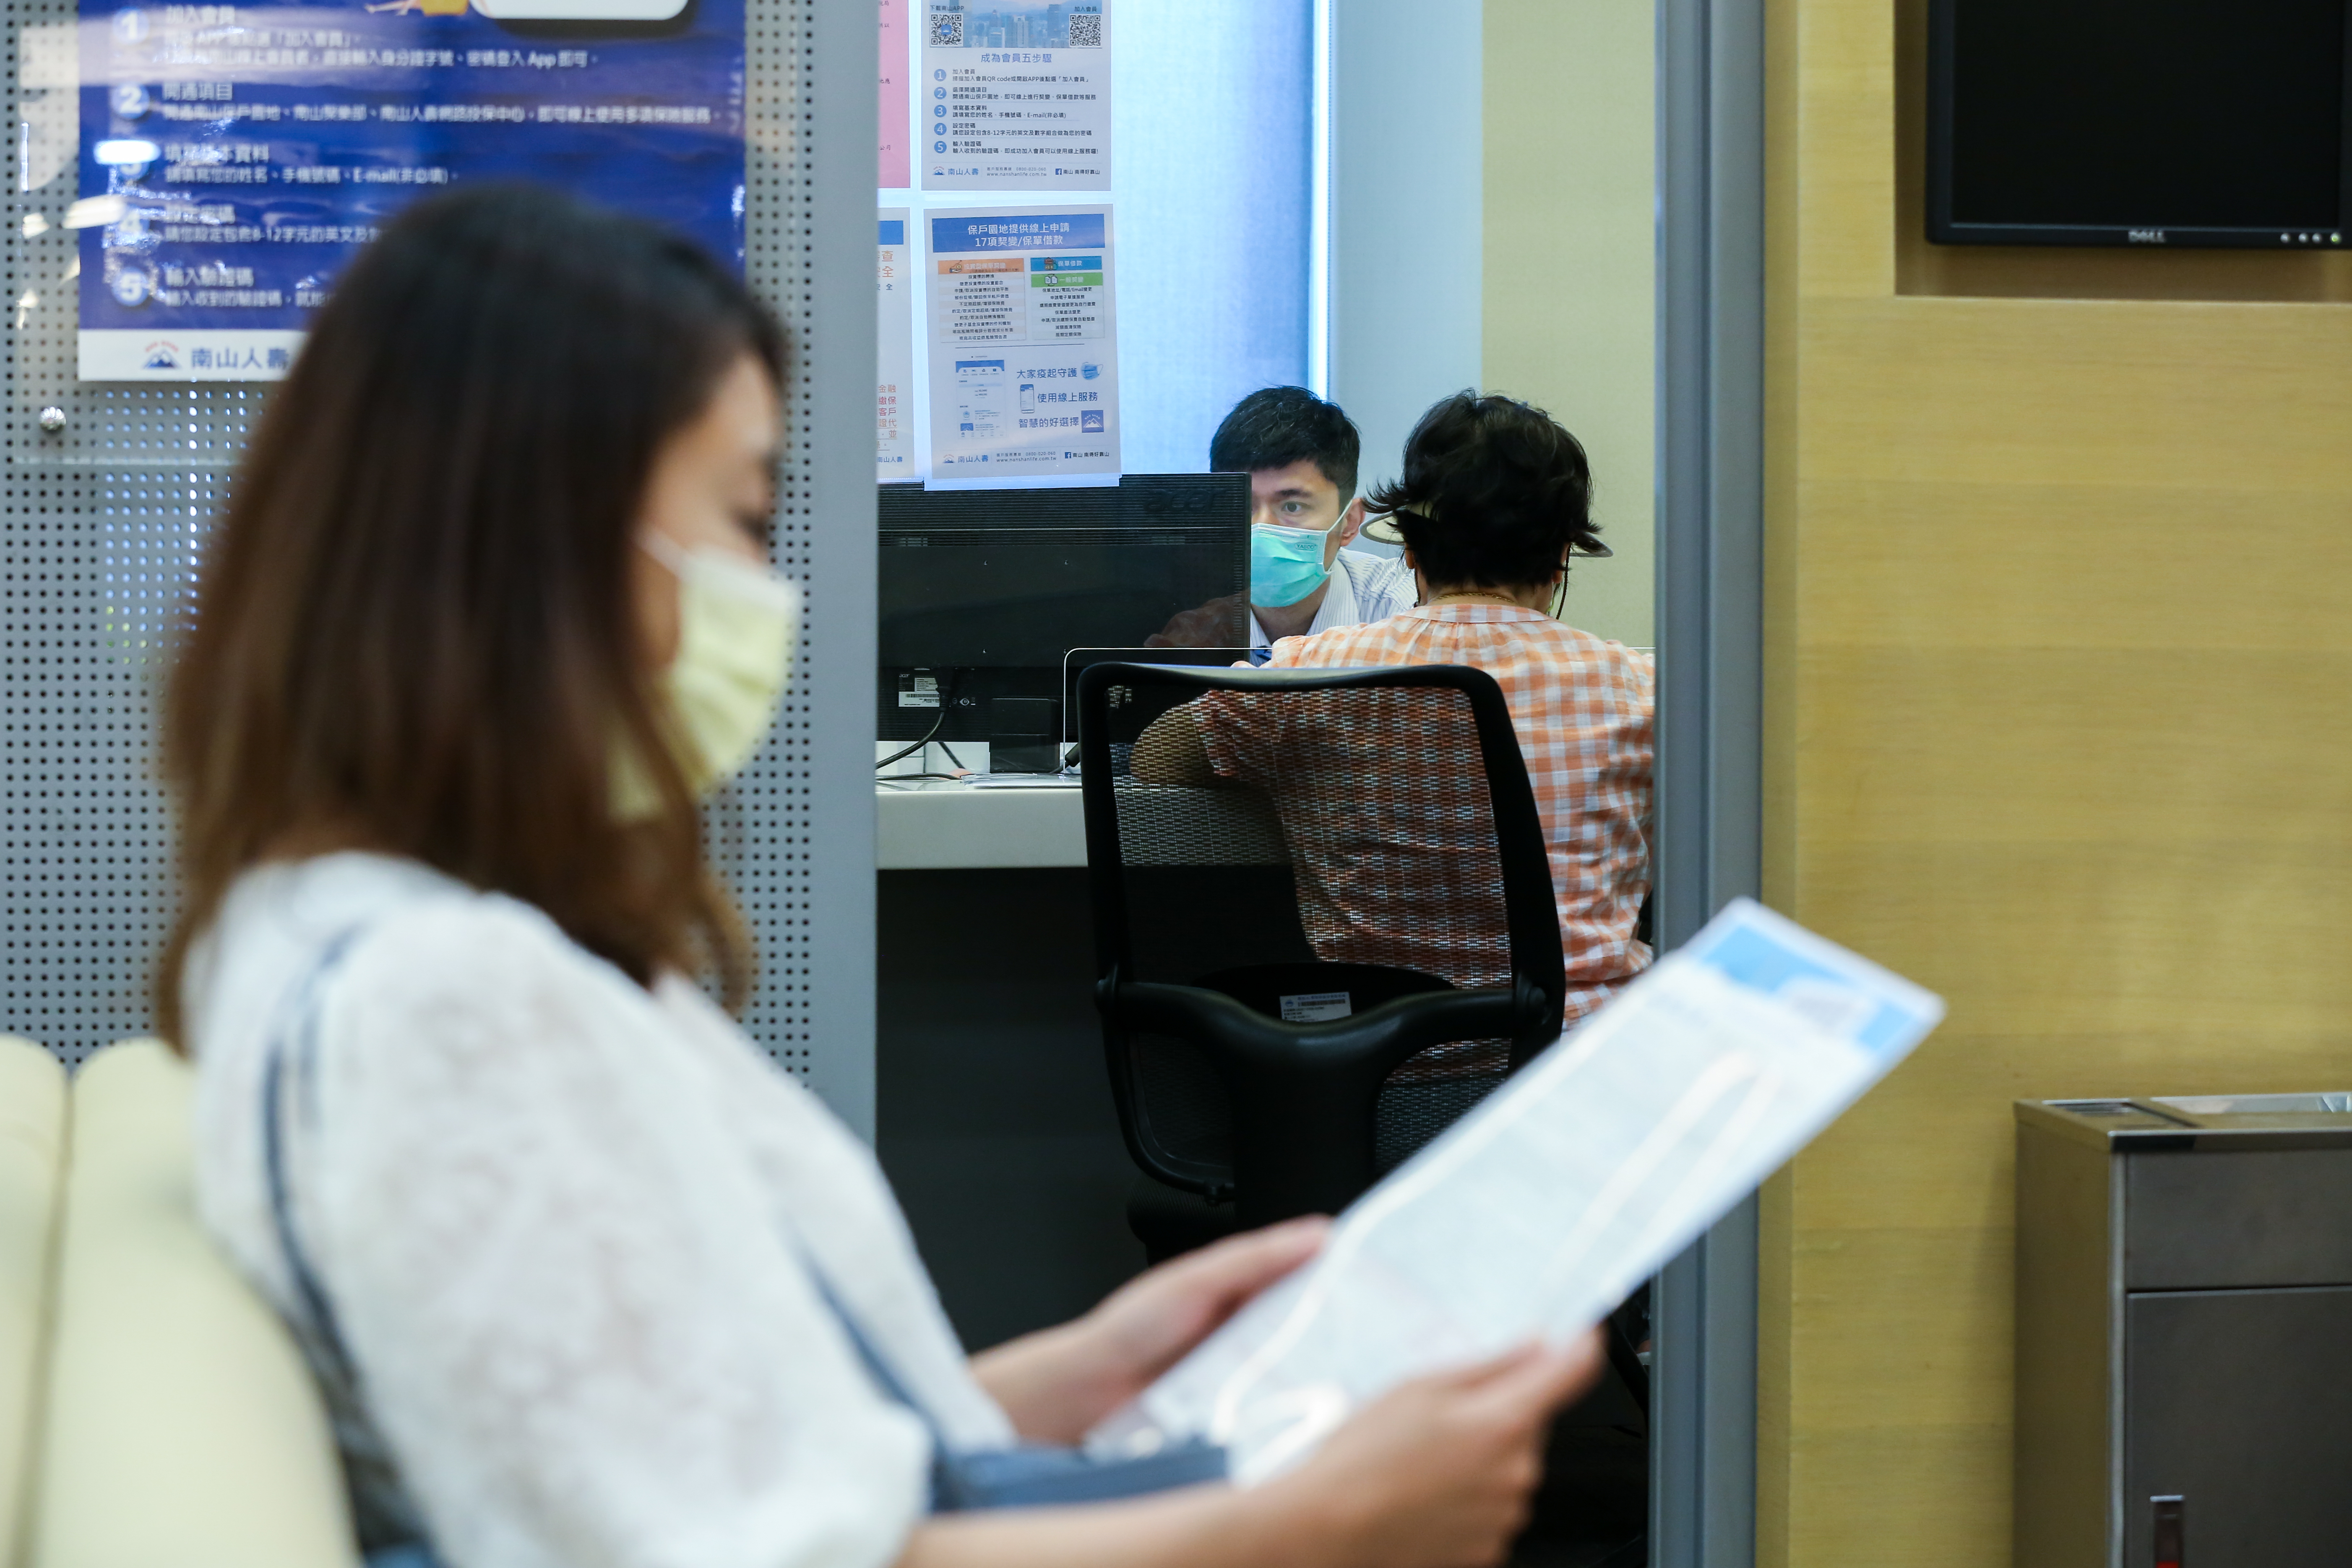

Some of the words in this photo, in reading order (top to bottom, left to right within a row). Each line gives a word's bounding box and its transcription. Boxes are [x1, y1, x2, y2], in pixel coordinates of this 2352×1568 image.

[981, 53, 1052, 63] 成為會員五步驟
[968, 223, 1069, 235] 保戶園地提供線上申請
[975, 235, 1063, 247] 17項契變/保單借款
[1016, 368, 1077, 379] 大家疫起守護
[878, 385, 896, 393] 金融
[1038, 392, 1098, 403] 使用線上服務
[878, 407, 896, 416] 客戶
[1018, 417, 1079, 428] 智慧的好選擇
[958, 455, 988, 463] 南山人壽
